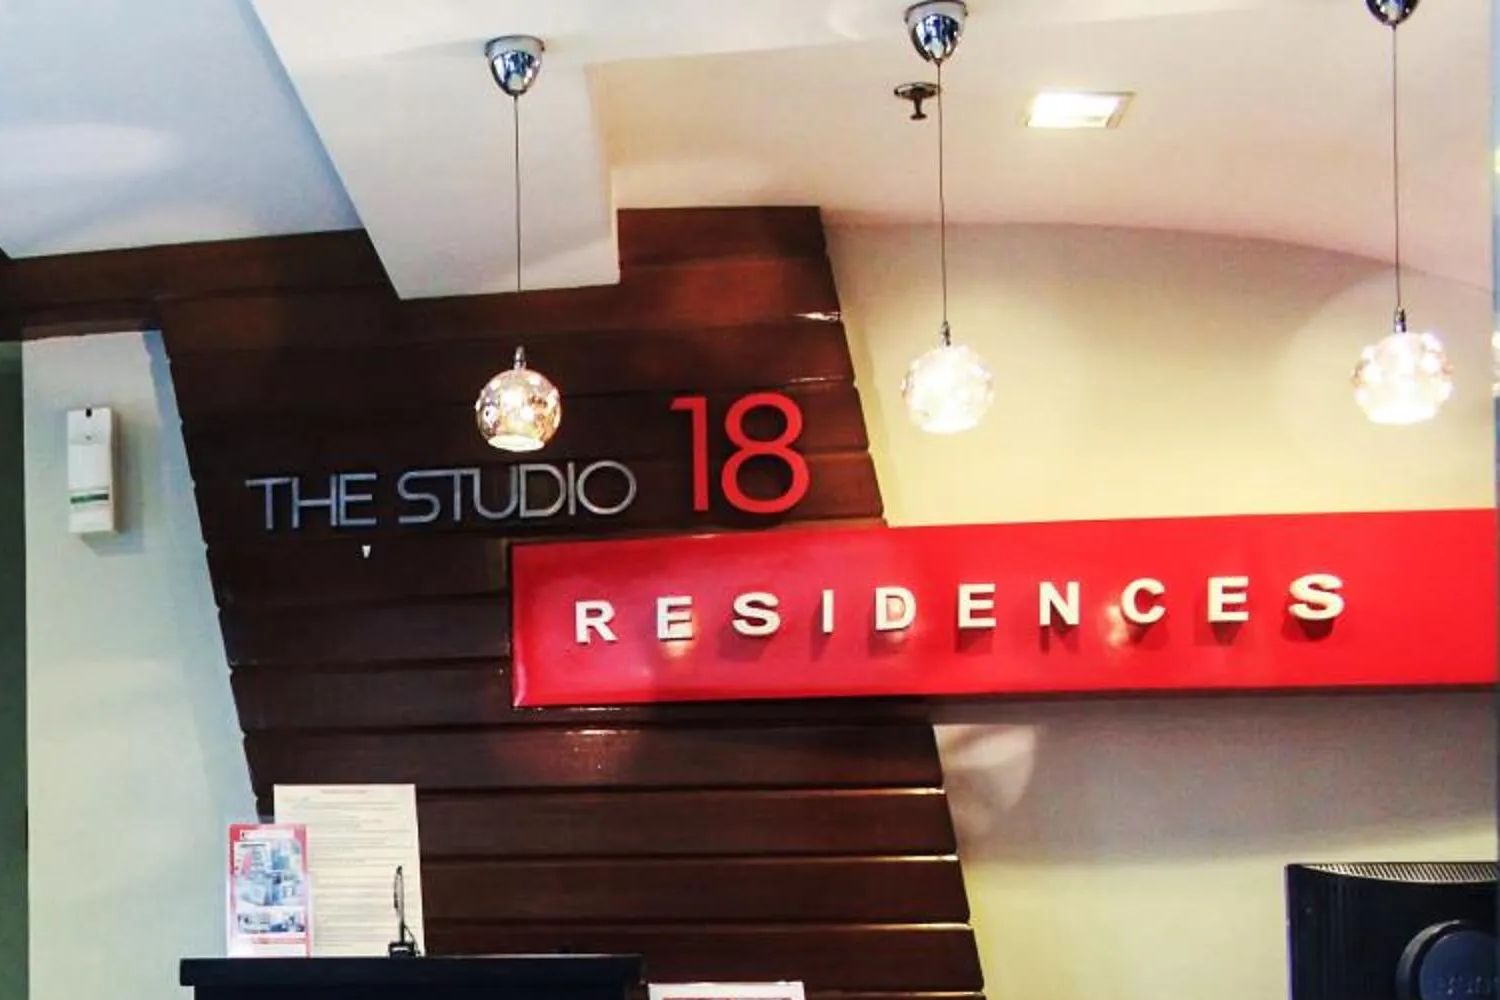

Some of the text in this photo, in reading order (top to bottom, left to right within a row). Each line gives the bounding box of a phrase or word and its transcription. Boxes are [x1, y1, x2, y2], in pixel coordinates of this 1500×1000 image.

[245, 392, 810, 529] THE STUDIO 18
[574, 573, 1346, 644] RESIDENCES
